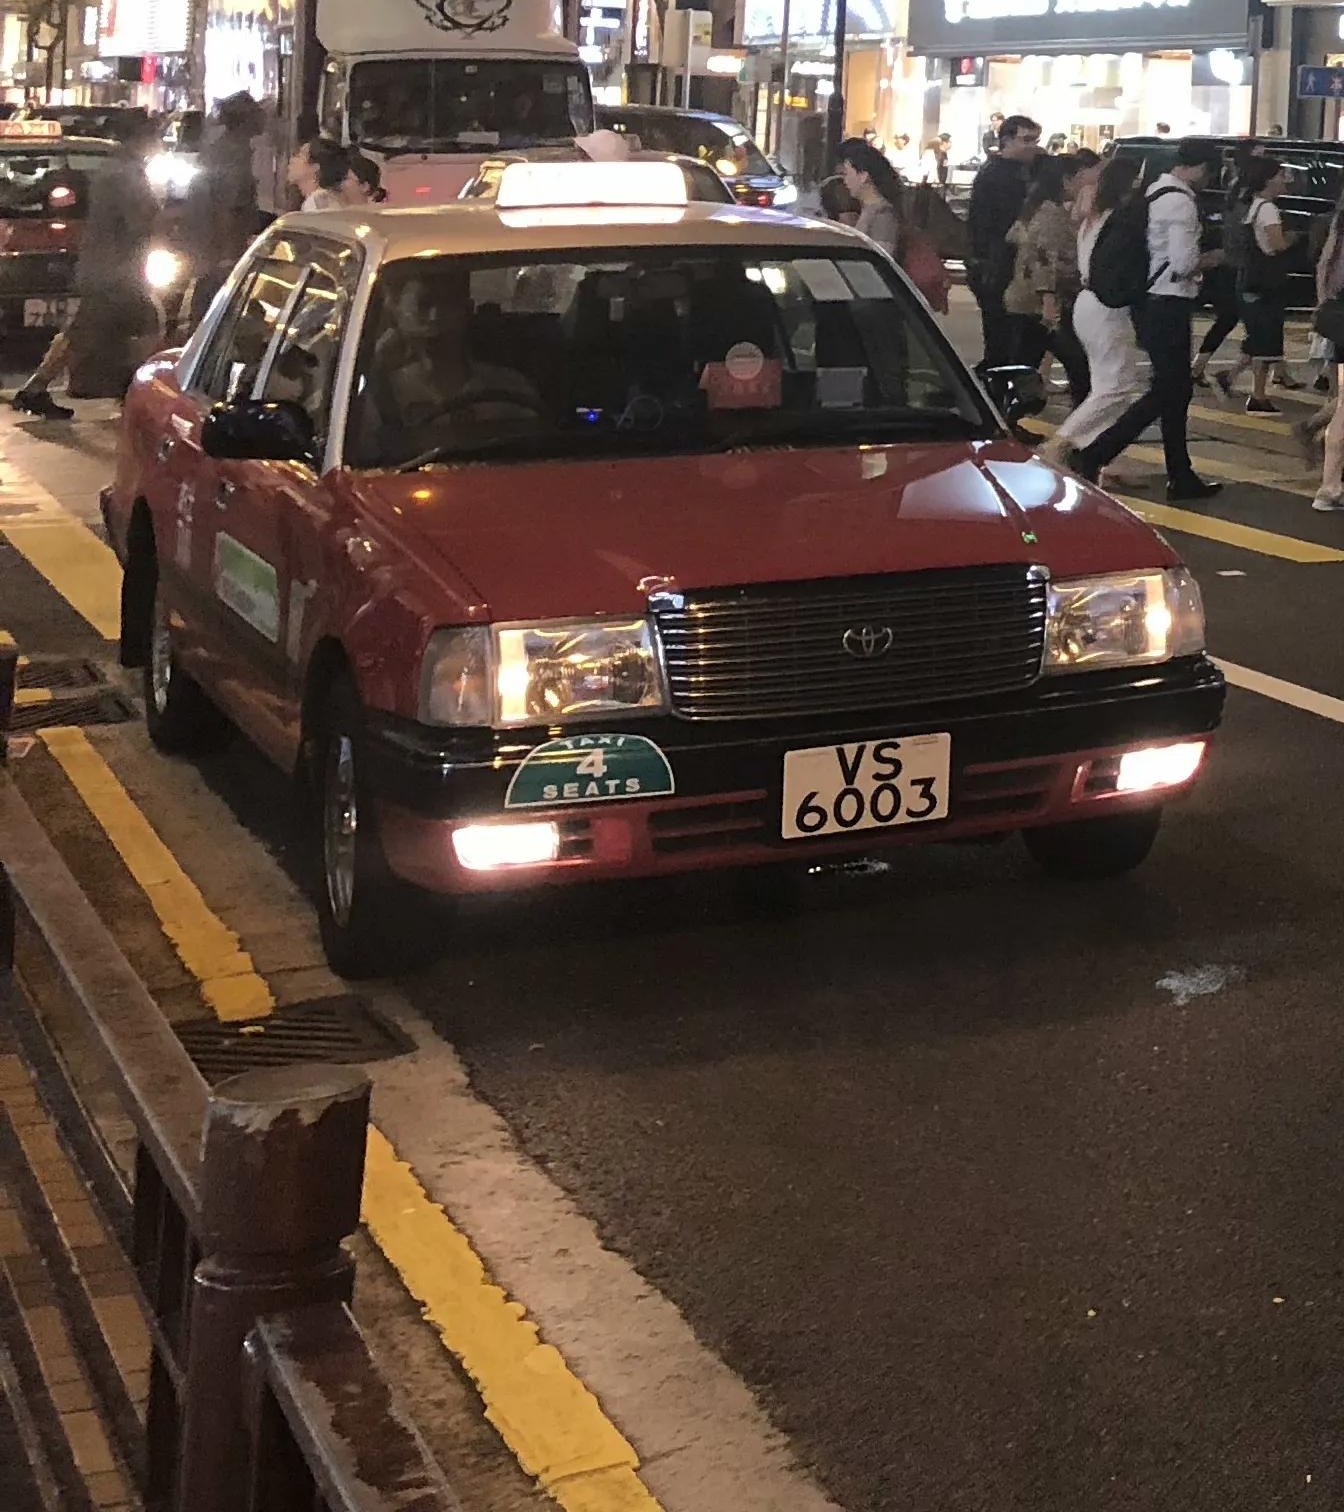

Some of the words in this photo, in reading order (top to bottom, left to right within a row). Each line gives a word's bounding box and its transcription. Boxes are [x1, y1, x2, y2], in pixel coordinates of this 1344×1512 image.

[559, 736, 625, 750] TAXI
[575, 748, 608, 778] 4
[836, 742, 904, 788] VS
[542, 778, 641, 800] SEATS
[796, 777, 938, 834] 6003
